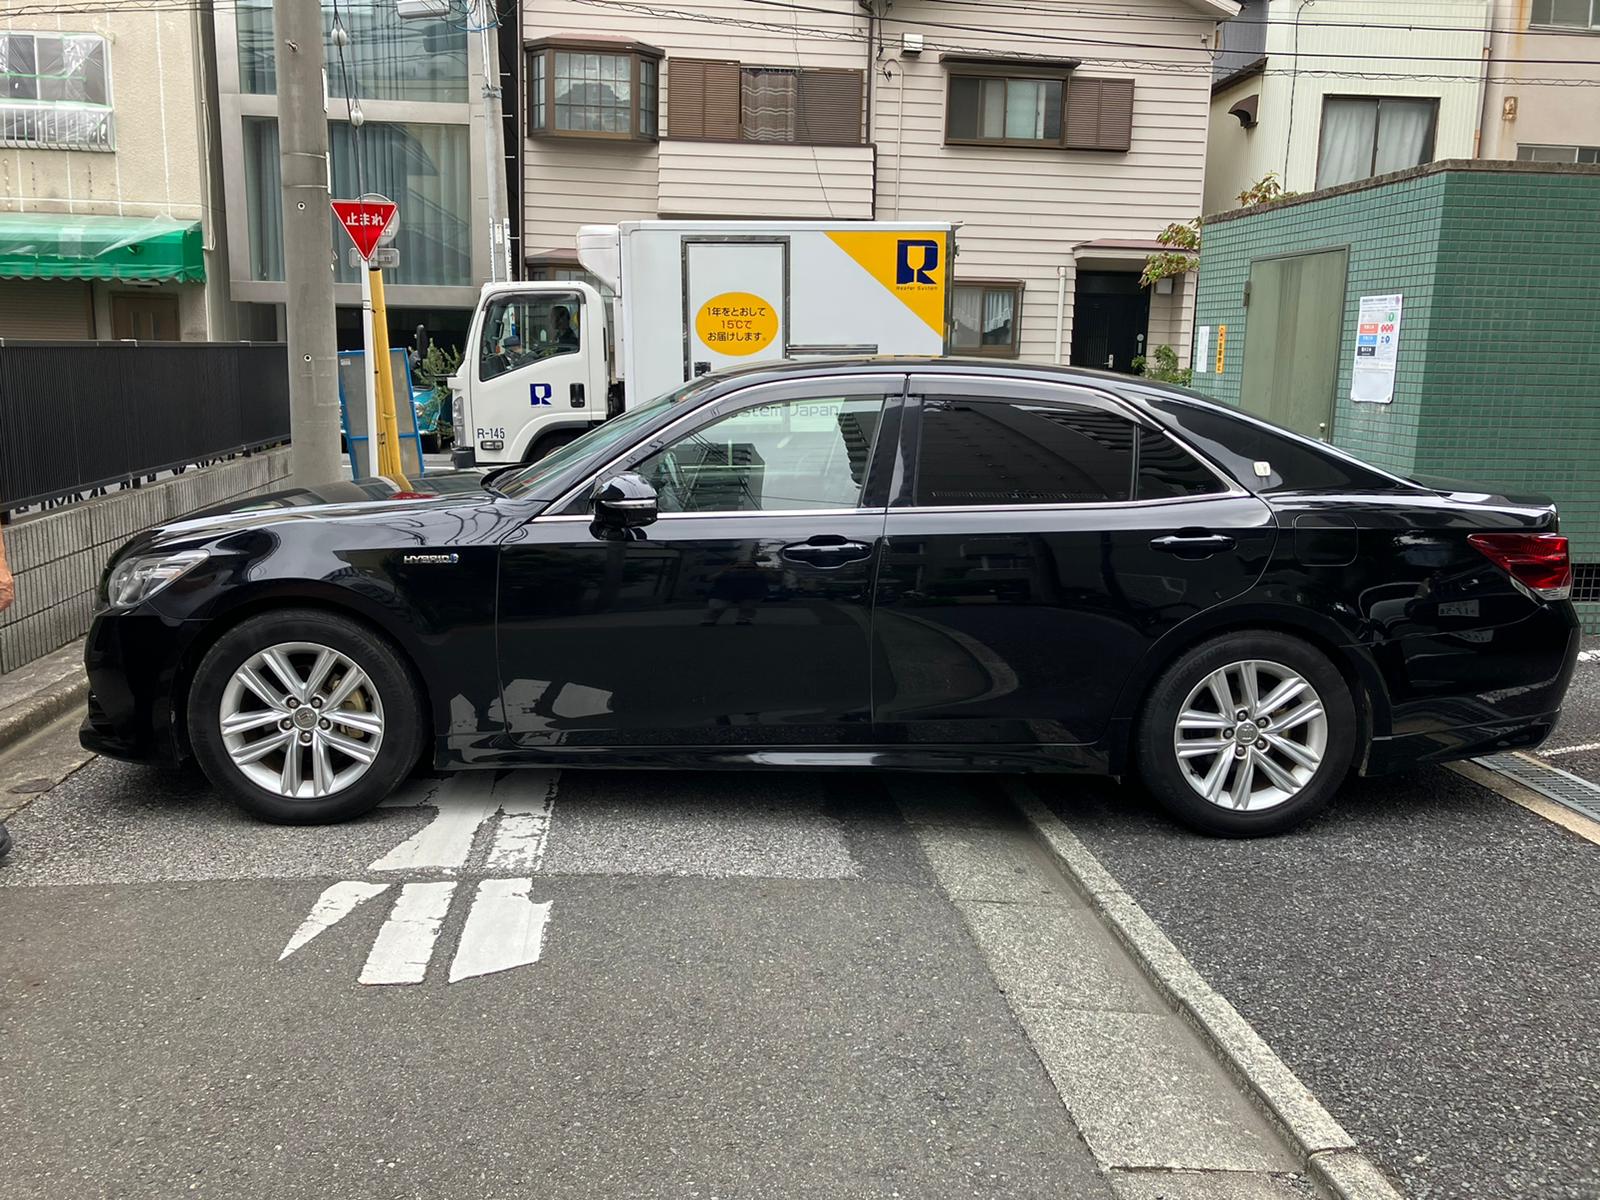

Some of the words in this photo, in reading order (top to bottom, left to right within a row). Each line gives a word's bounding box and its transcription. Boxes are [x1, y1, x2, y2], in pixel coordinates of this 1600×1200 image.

[345, 211, 384, 226] 止まれ
[707, 307, 766, 317] 1年をとおして
[707, 332, 767, 341] お届けします。
[790, 403, 839, 419] Japan
[477, 428, 505, 439] R-145
[403, 555, 449, 564] HYBRID
